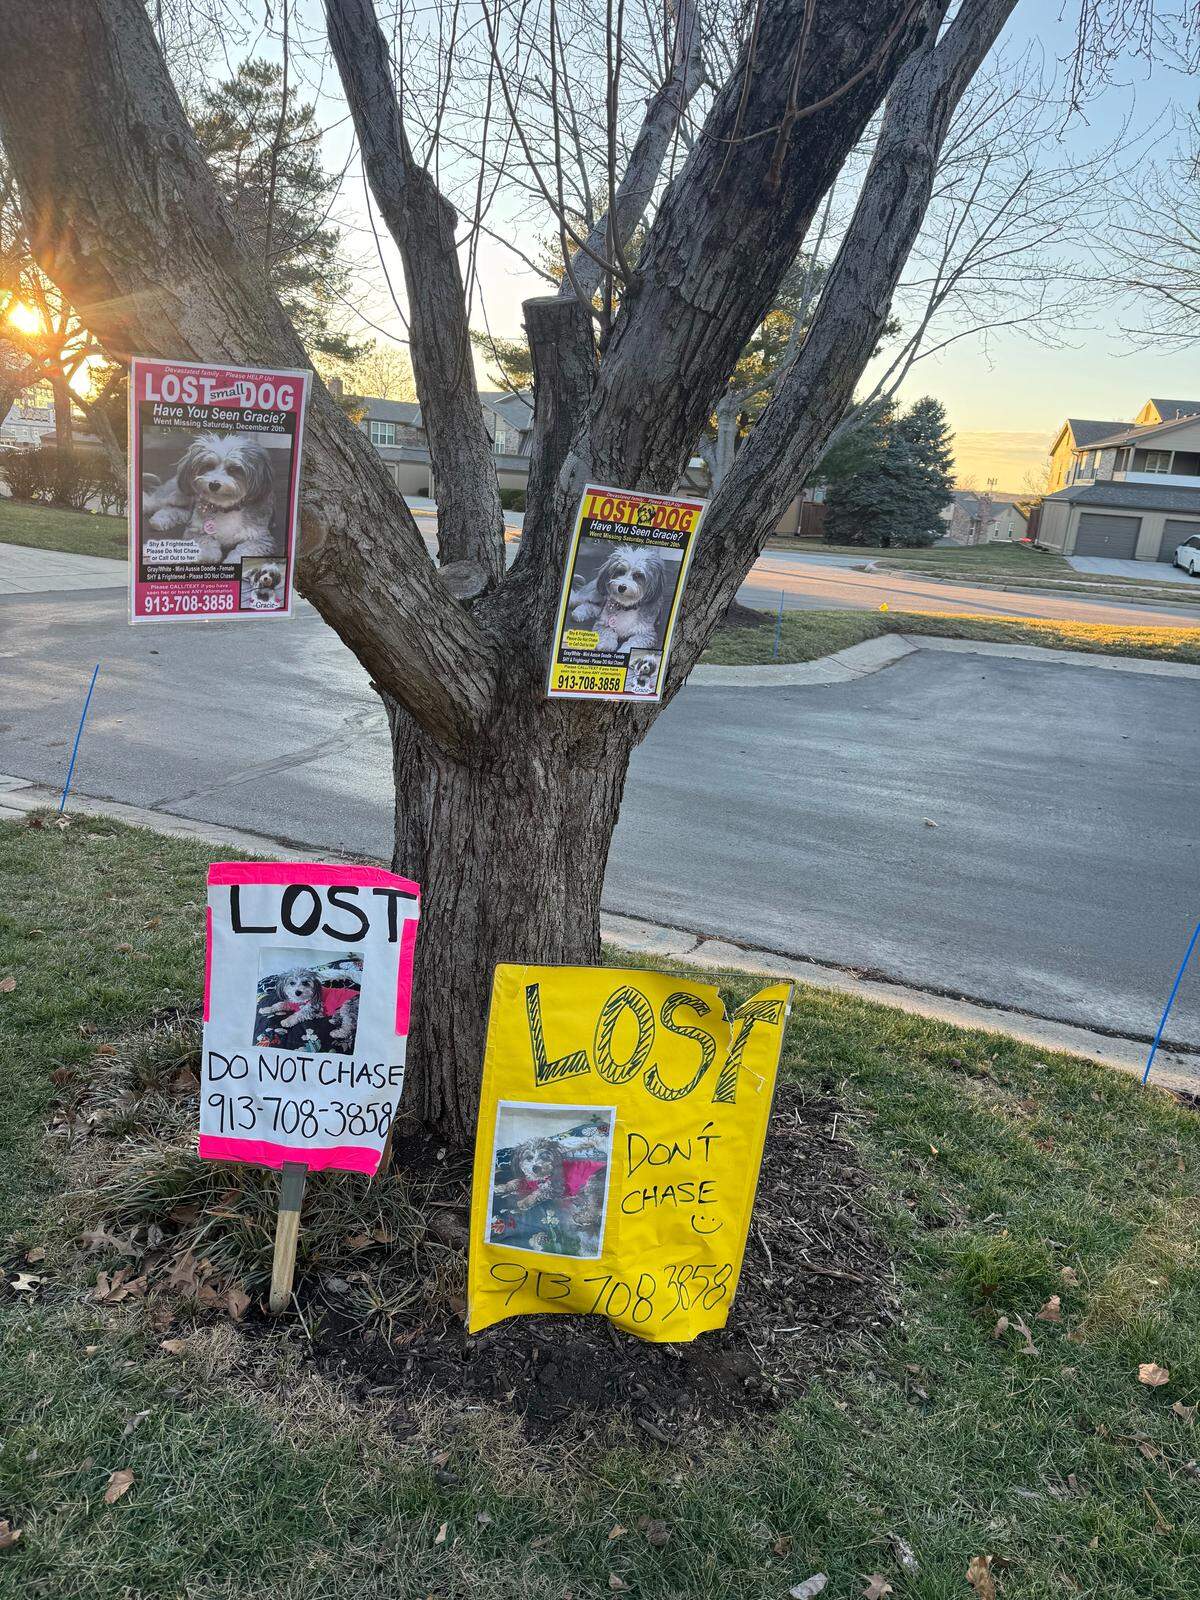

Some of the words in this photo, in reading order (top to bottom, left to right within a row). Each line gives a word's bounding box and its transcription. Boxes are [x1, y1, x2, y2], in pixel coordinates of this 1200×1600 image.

[165, 366, 200, 374] Devastated
[146, 372, 216, 404] LOST
[240, 382, 294, 412] DOG
[210, 383, 245, 400] small
[153, 404, 183, 418] Have
[187, 406, 208, 420] You
[212, 408, 240, 421] Seen
[243, 410, 286, 424] Gracie?
[154, 418, 172, 426] Went
[174, 419, 200, 428] Missing
[202, 420, 234, 430] Saturday,
[236, 424, 269, 432] December
[588, 496, 640, 524] LOST
[653, 506, 694, 531] DOG
[590, 520, 612, 532] Have
[614, 523, 629, 534] You
[630, 526, 651, 537] Seen
[652, 529, 684, 541] Gracie?
[603, 532, 622, 541] Missing
[646, 538, 669, 546] December
[144, 594, 234, 612] 913-708-3858
[558, 675, 620, 691] 913-708-3858
[230, 884, 417, 943] LOST
[526, 983, 784, 1104] LOST
[209, 1051, 248, 1081] DO
[259, 1054, 314, 1083] NOT
[319, 1059, 404, 1089] CHASE
[208, 1093, 393, 1139] 913-708-3858
[627, 1122, 722, 1178] DON'T
[621, 1180, 719, 1214] CHASE
[490, 1262, 571, 1306] 913
[584, 1273, 656, 1323] 708
[661, 1263, 733, 1322] 3858
